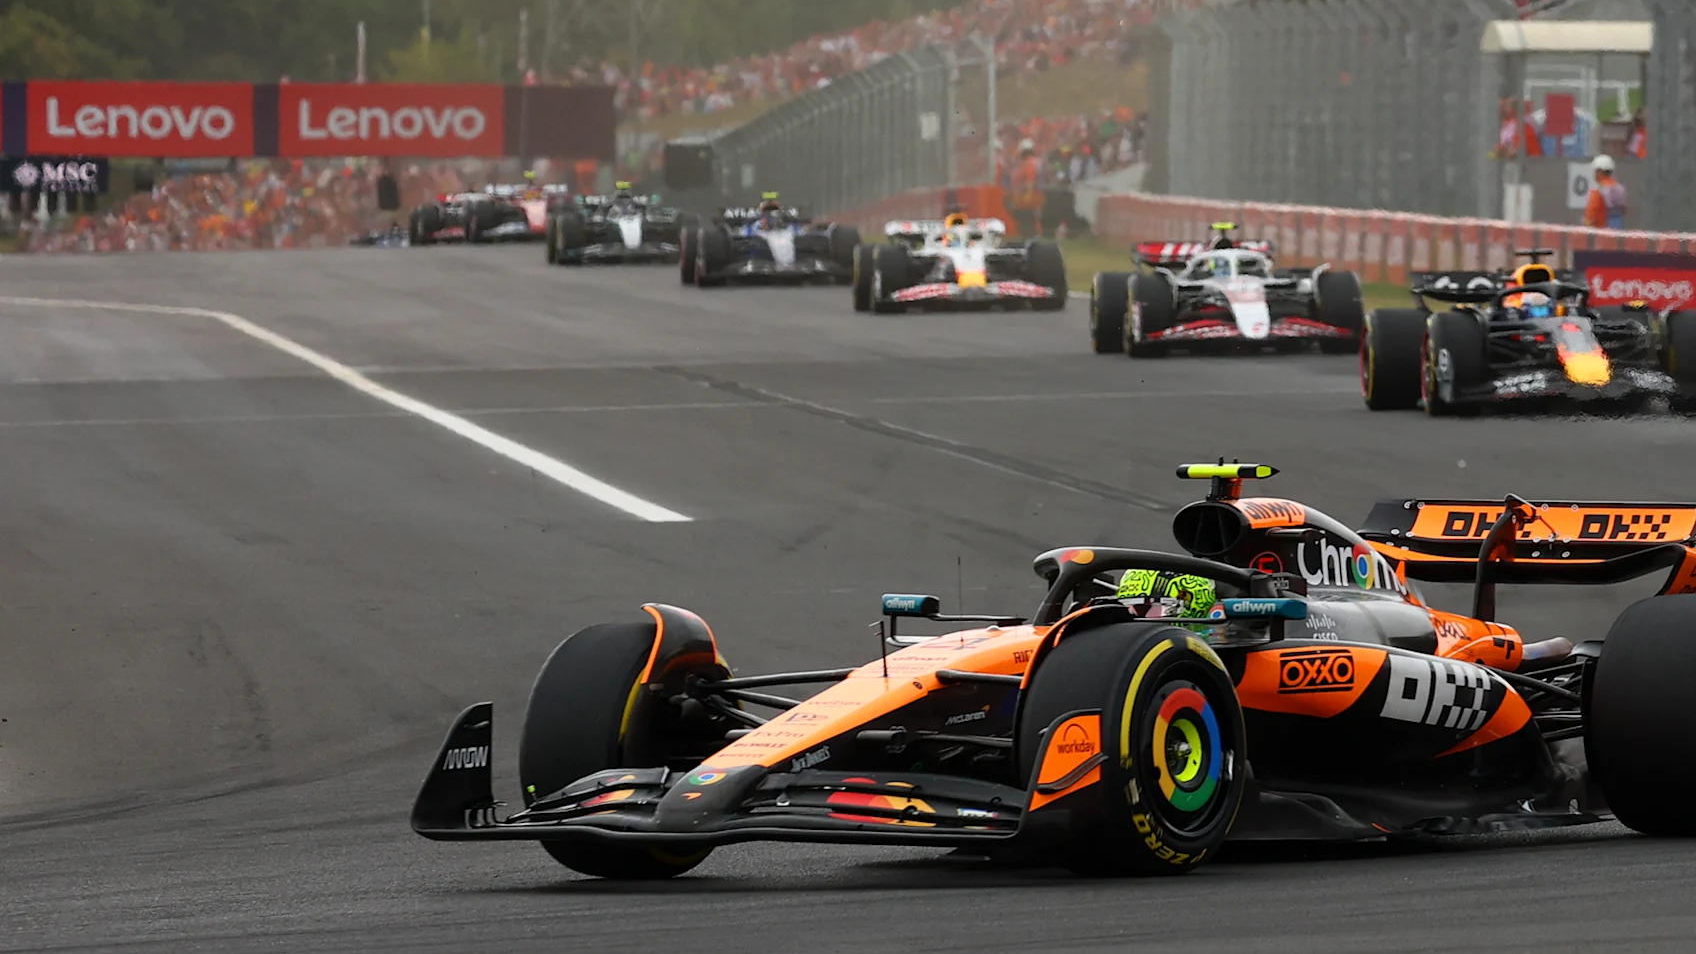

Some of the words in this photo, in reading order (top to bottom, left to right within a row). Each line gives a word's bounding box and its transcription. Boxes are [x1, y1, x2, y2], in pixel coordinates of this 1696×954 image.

[46, 96, 236, 139] Lenovo
[298, 99, 486, 139] Lenovo
[42, 161, 98, 181] MSC
[1592, 275, 1694, 301] Lenovo
[885, 598, 916, 611] allwyn
[1232, 601, 1276, 614] allwyn
[1281, 656, 1353, 687] OXXO
[945, 709, 986, 726] McLaren
[1057, 738, 1096, 755] workday
